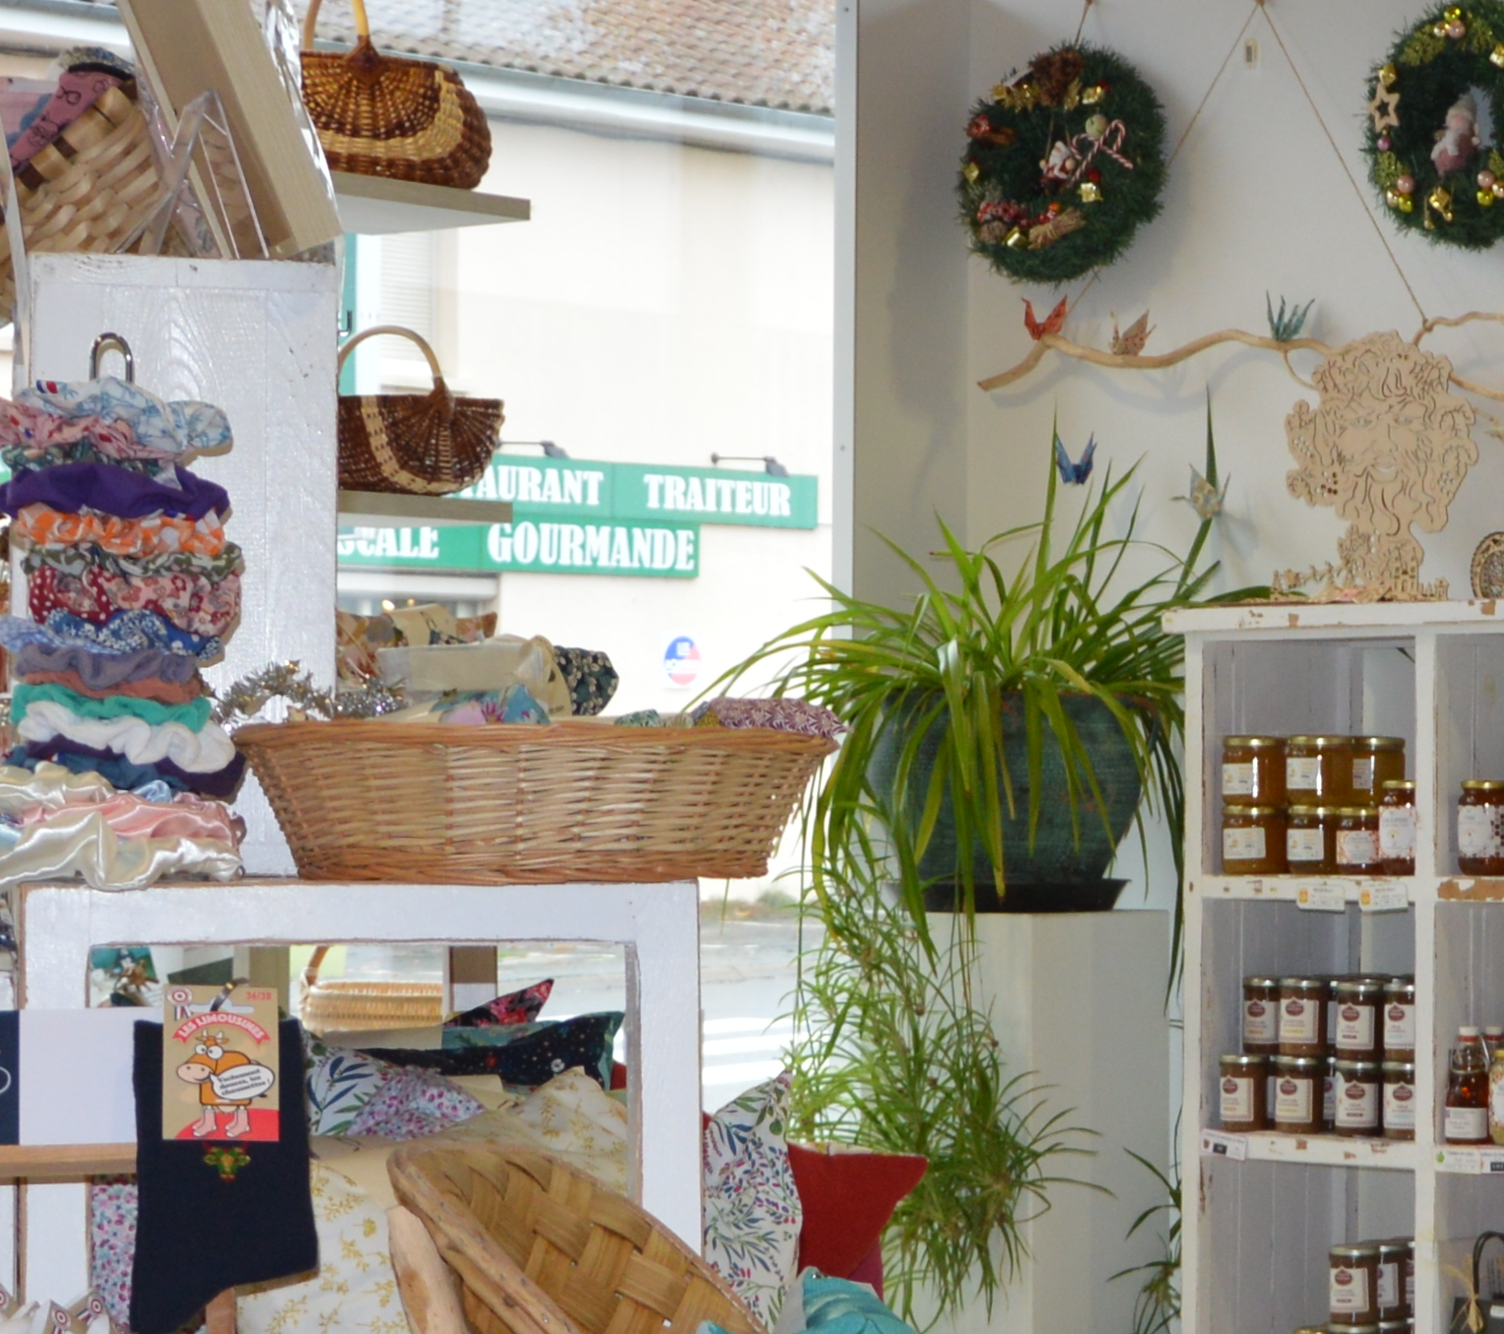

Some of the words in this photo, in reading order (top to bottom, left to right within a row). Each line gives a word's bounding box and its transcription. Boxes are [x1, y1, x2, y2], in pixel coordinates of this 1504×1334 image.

[643, 474, 792, 516] TRAITEUR
[487, 520, 695, 571] GOURMANDE
[178, 1022, 197, 1038] LES
[195, 1012, 266, 1040] LIMOUSINES
